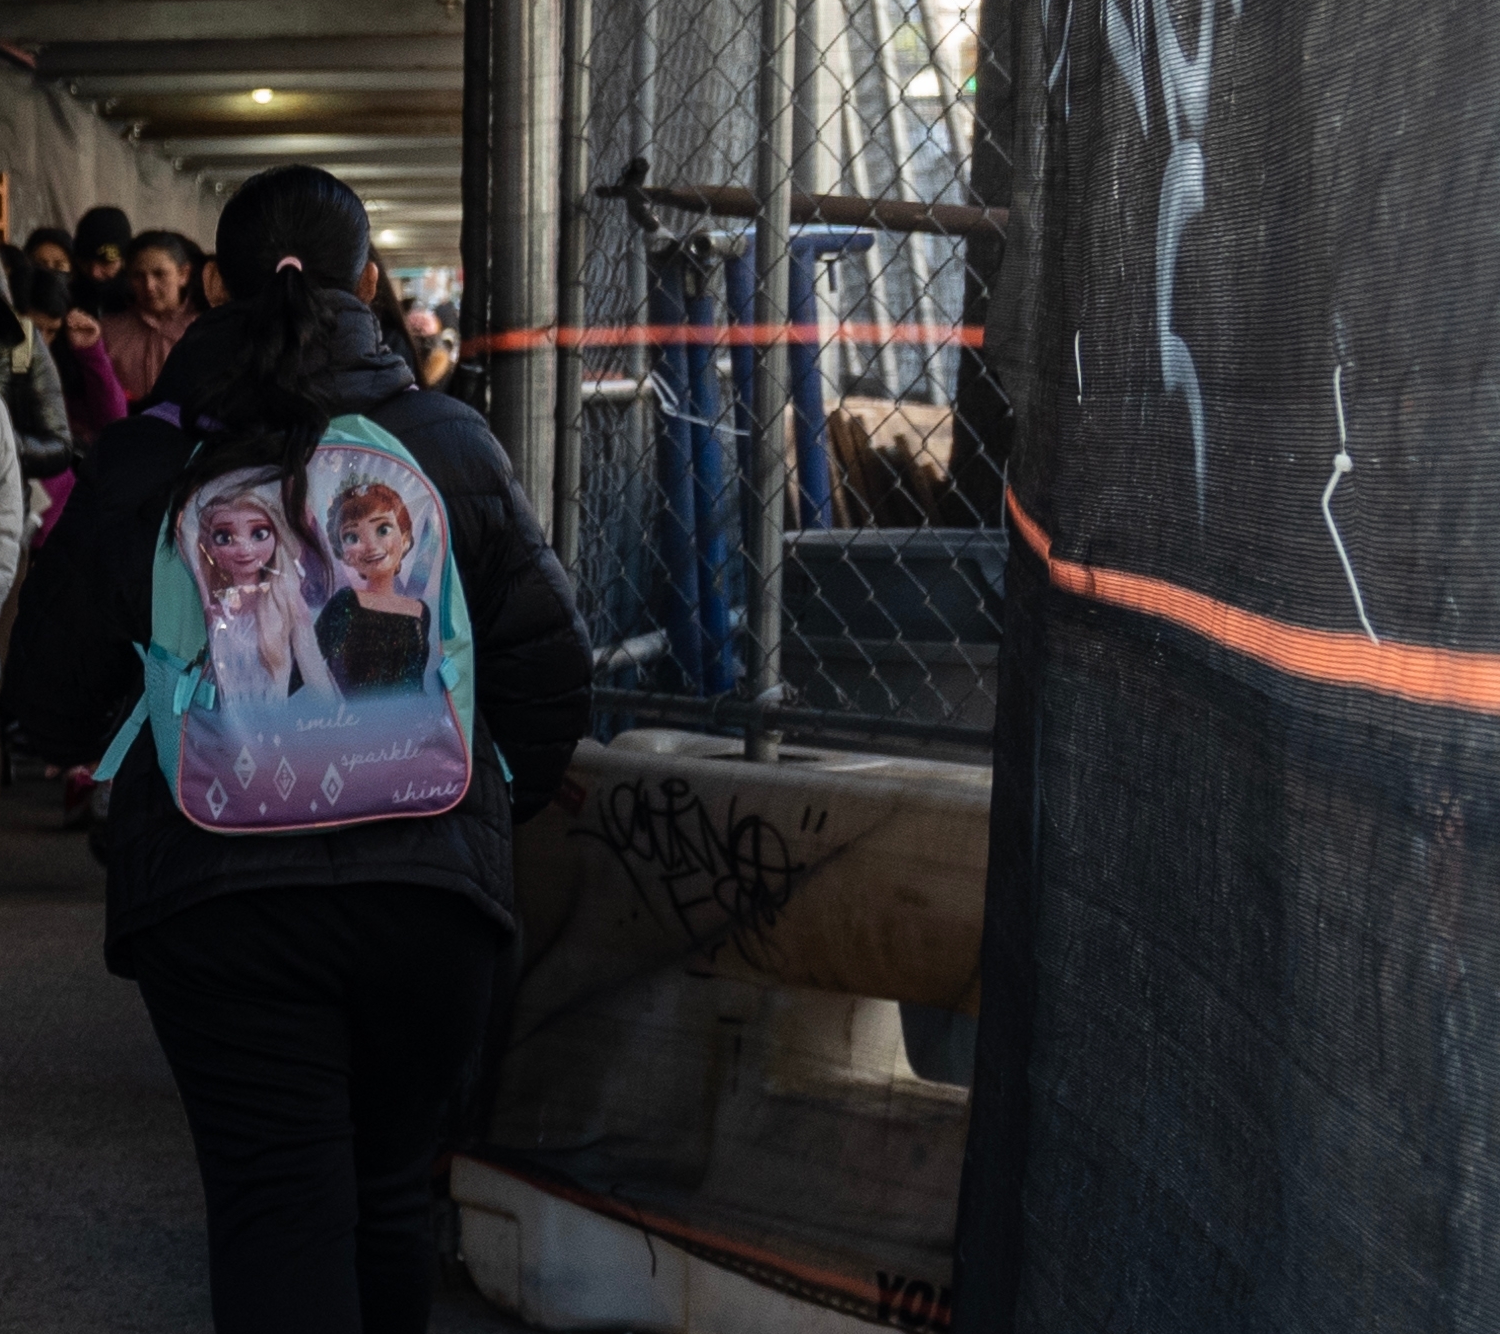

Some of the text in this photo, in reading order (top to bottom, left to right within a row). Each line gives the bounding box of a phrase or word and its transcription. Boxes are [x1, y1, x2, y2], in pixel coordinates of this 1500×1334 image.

[295, 703, 360, 733] smile
[341, 738, 424, 772] sparkle
[392, 780, 459, 804] shine
